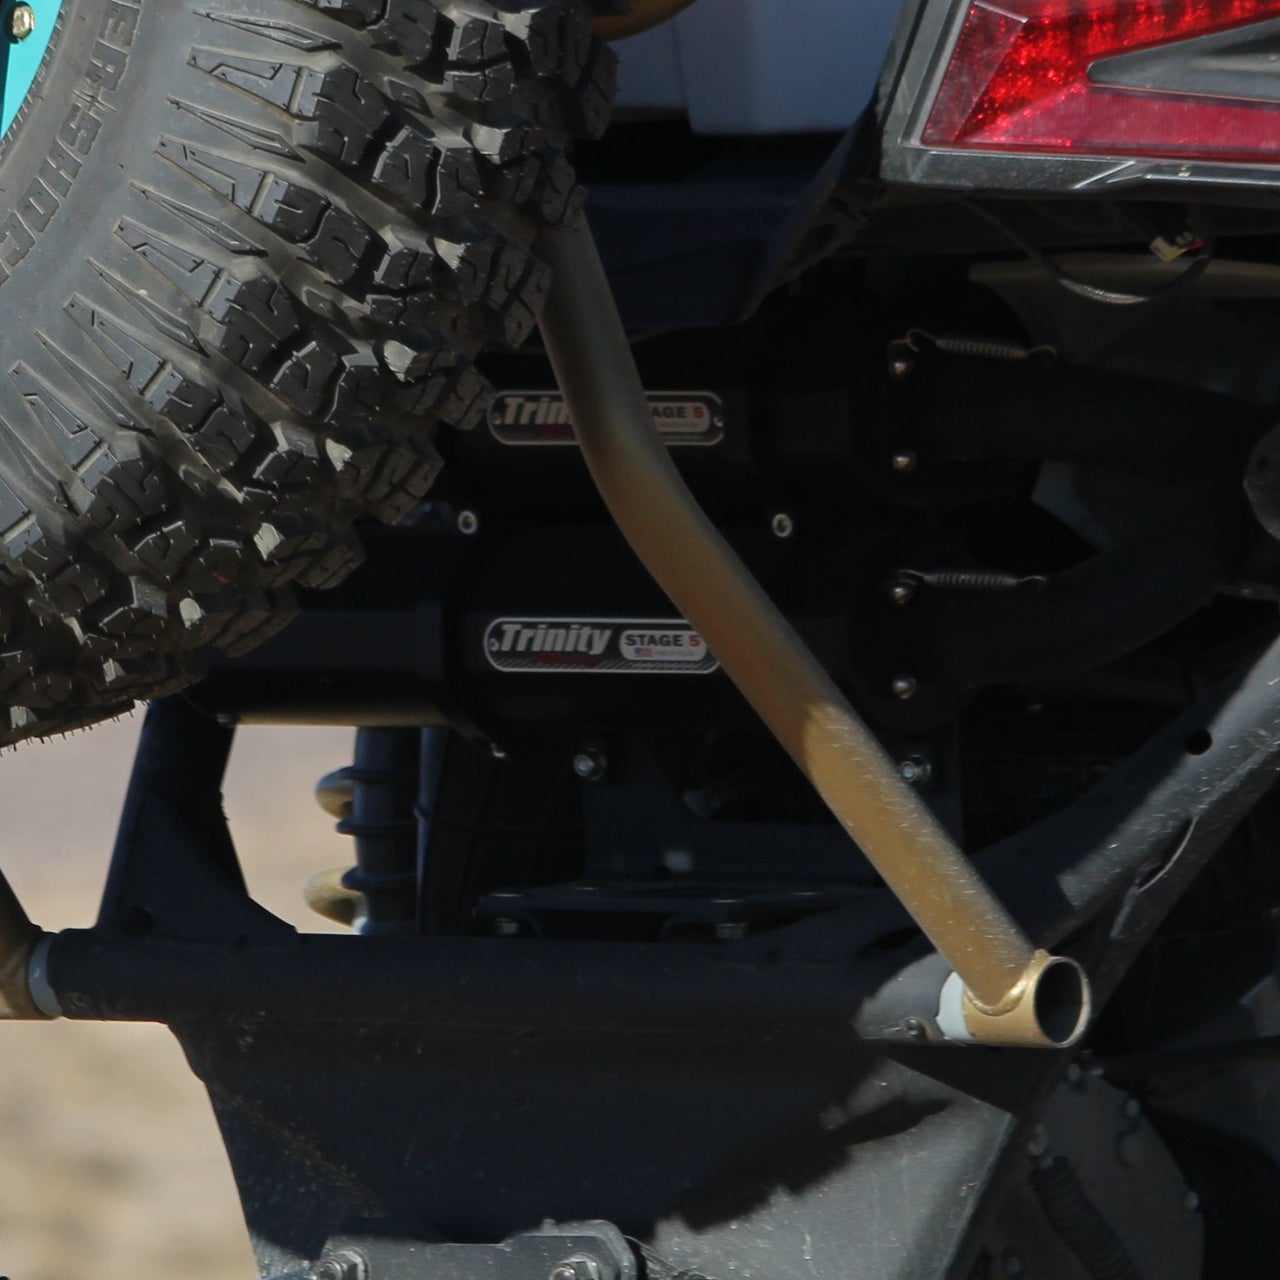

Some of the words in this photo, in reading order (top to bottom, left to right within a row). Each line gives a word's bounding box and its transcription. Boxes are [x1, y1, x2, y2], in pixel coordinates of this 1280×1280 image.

[503, 396, 575, 426] Trin
[651, 406, 688, 419] AGE
[692, 406, 705, 419] 5
[500, 623, 612, 655] Trinity
[625, 634, 683, 647] STAGE
[690, 634, 701, 647] 5
